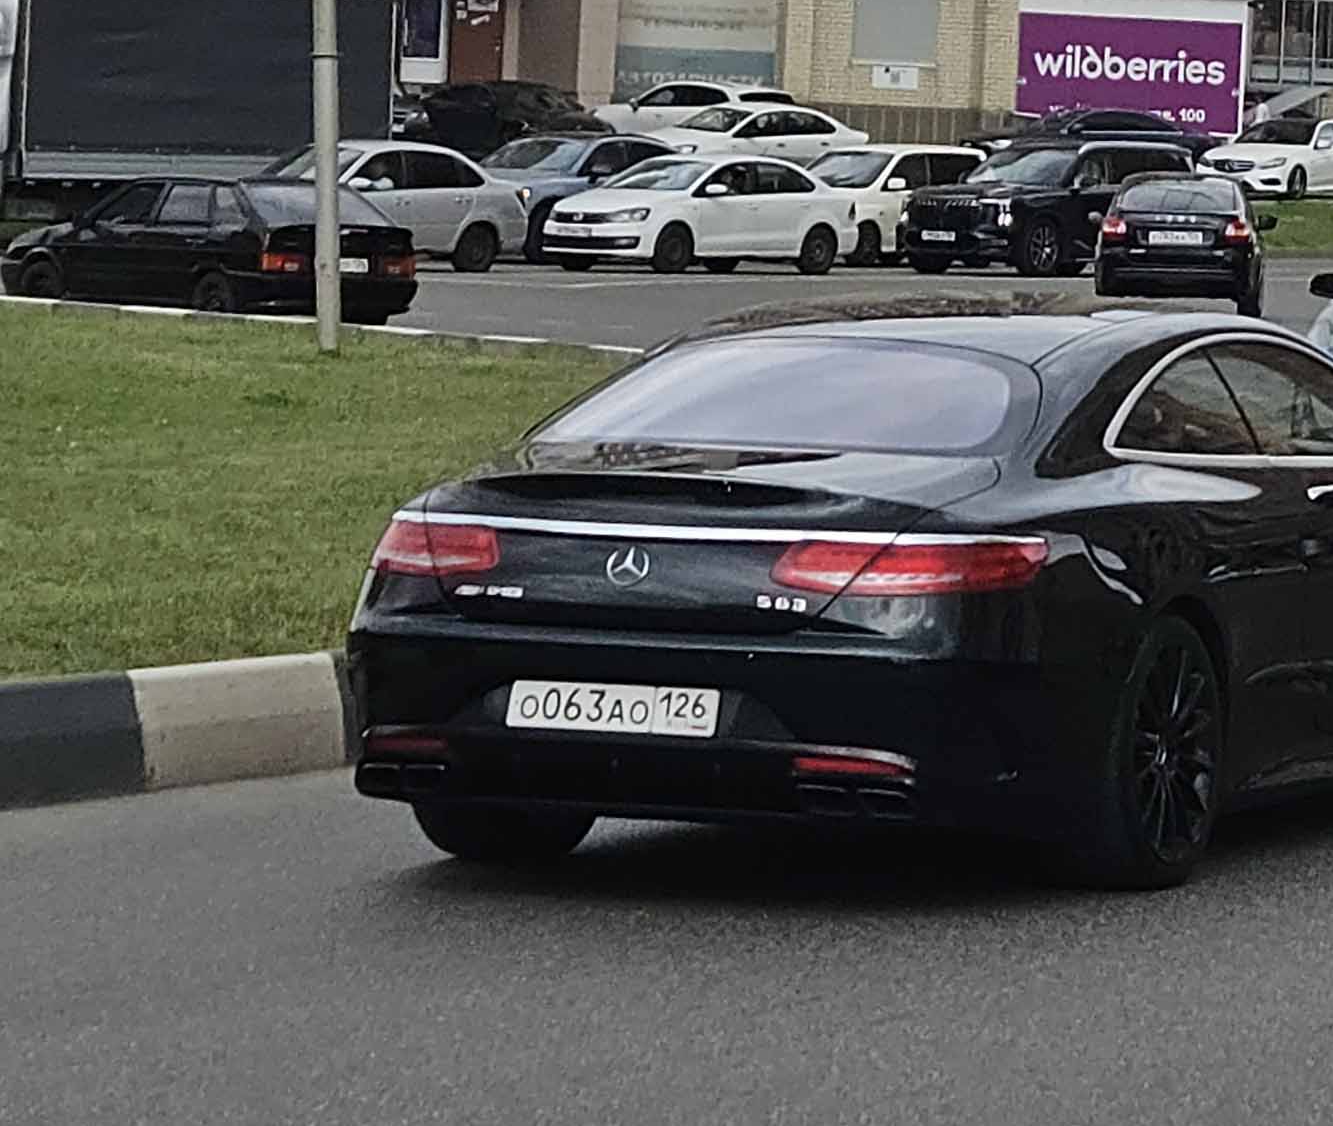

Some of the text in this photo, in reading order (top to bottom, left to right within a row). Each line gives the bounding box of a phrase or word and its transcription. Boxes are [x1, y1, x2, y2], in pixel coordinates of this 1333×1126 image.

[1033, 43, 1226, 86] wildberries
[1180, 107, 1206, 123] 100
[520, 687, 707, 724] О063АО 126
